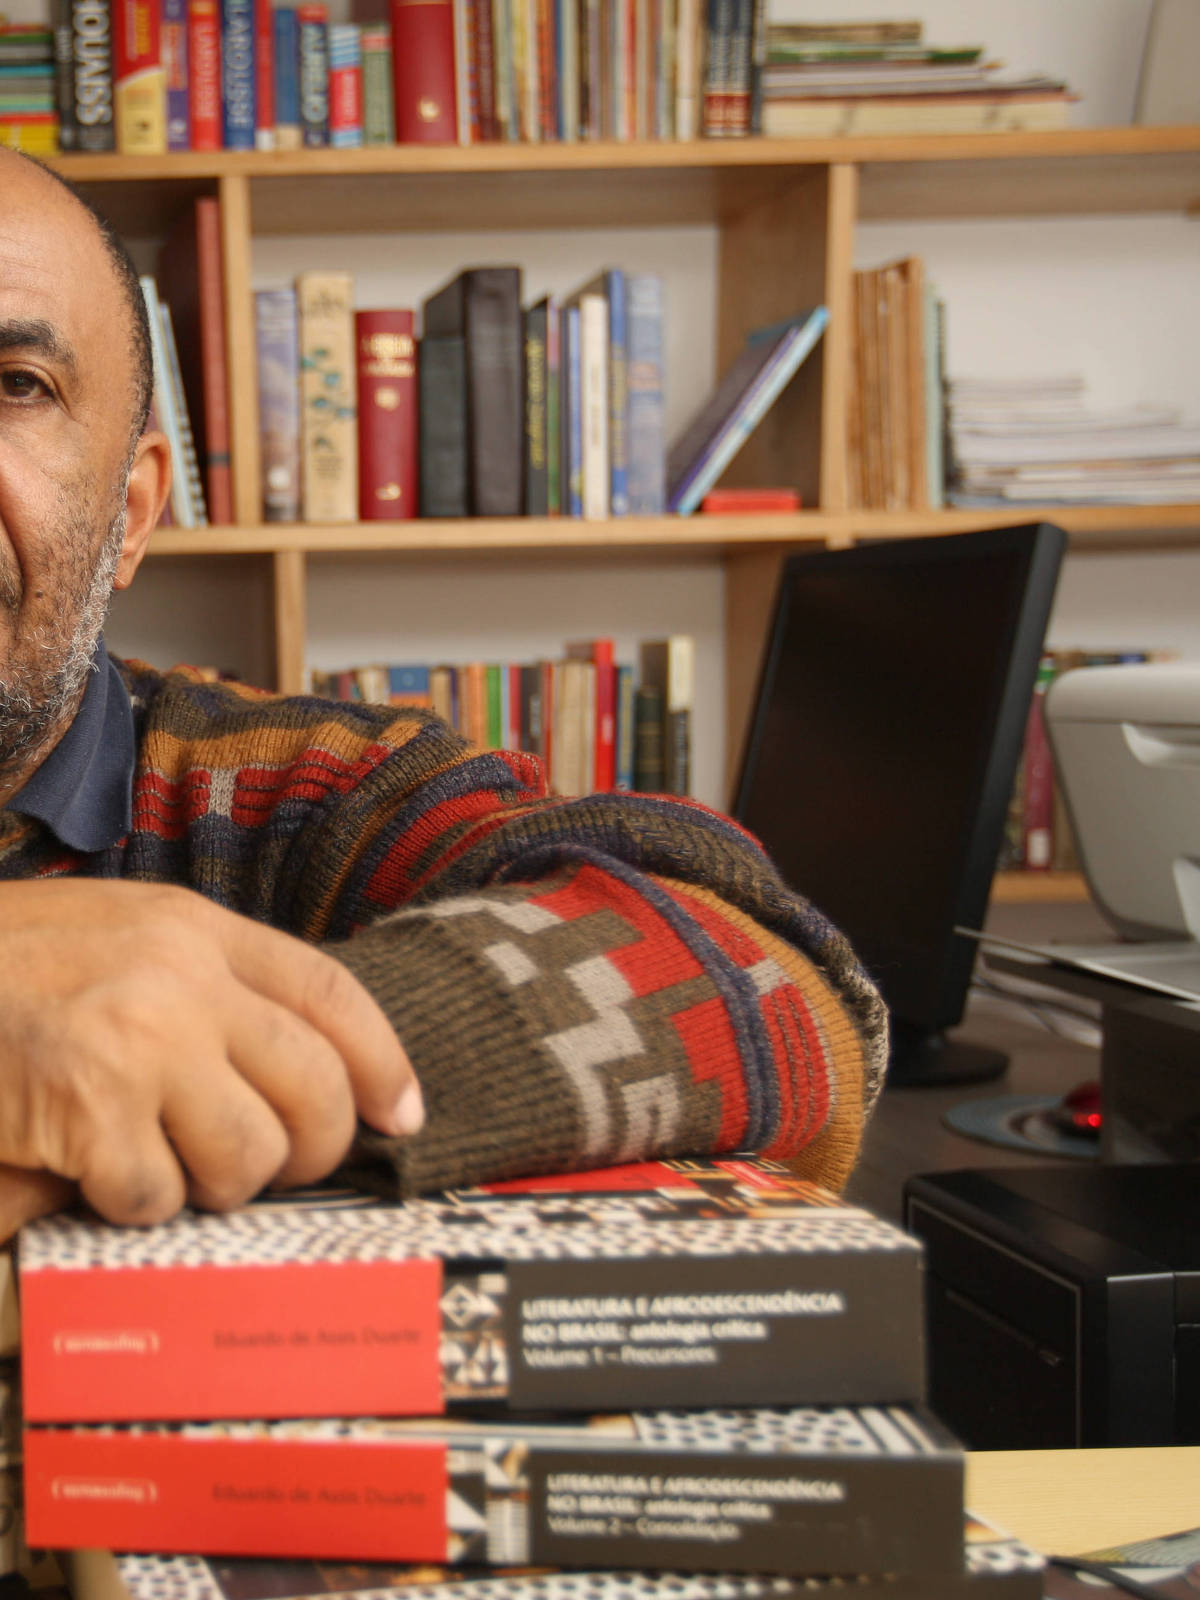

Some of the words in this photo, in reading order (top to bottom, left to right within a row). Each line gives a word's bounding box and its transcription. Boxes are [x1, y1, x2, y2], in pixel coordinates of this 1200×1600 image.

[522, 1297, 634, 1321] LITERATURA
[636, 1297, 649, 1317] E
[650, 1290, 843, 1315] AFRODESCENDÊNCIA
[523, 1323, 556, 1343] NO
[558, 1322, 626, 1343] BRASIL:
[629, 1320, 711, 1345] antologia
[712, 1319, 767, 1339] crítica
[523, 1347, 590, 1367] Volume
[593, 1346, 603, 1365] 1
[621, 1345, 717, 1365] Precursores
[547, 1474, 648, 1495] LITERATURA
[650, 1475, 662, 1495] E
[663, 1477, 844, 1500] AFRODESCENDÊNCIA
[547, 1495, 577, 1512] NO
[645, 1499, 719, 1522] antologia
[720, 1501, 773, 1520] crítica
[548, 1516, 606, 1535] Volume
[609, 1517, 621, 1535] 2
[636, 1517, 741, 1542] Consolidação
